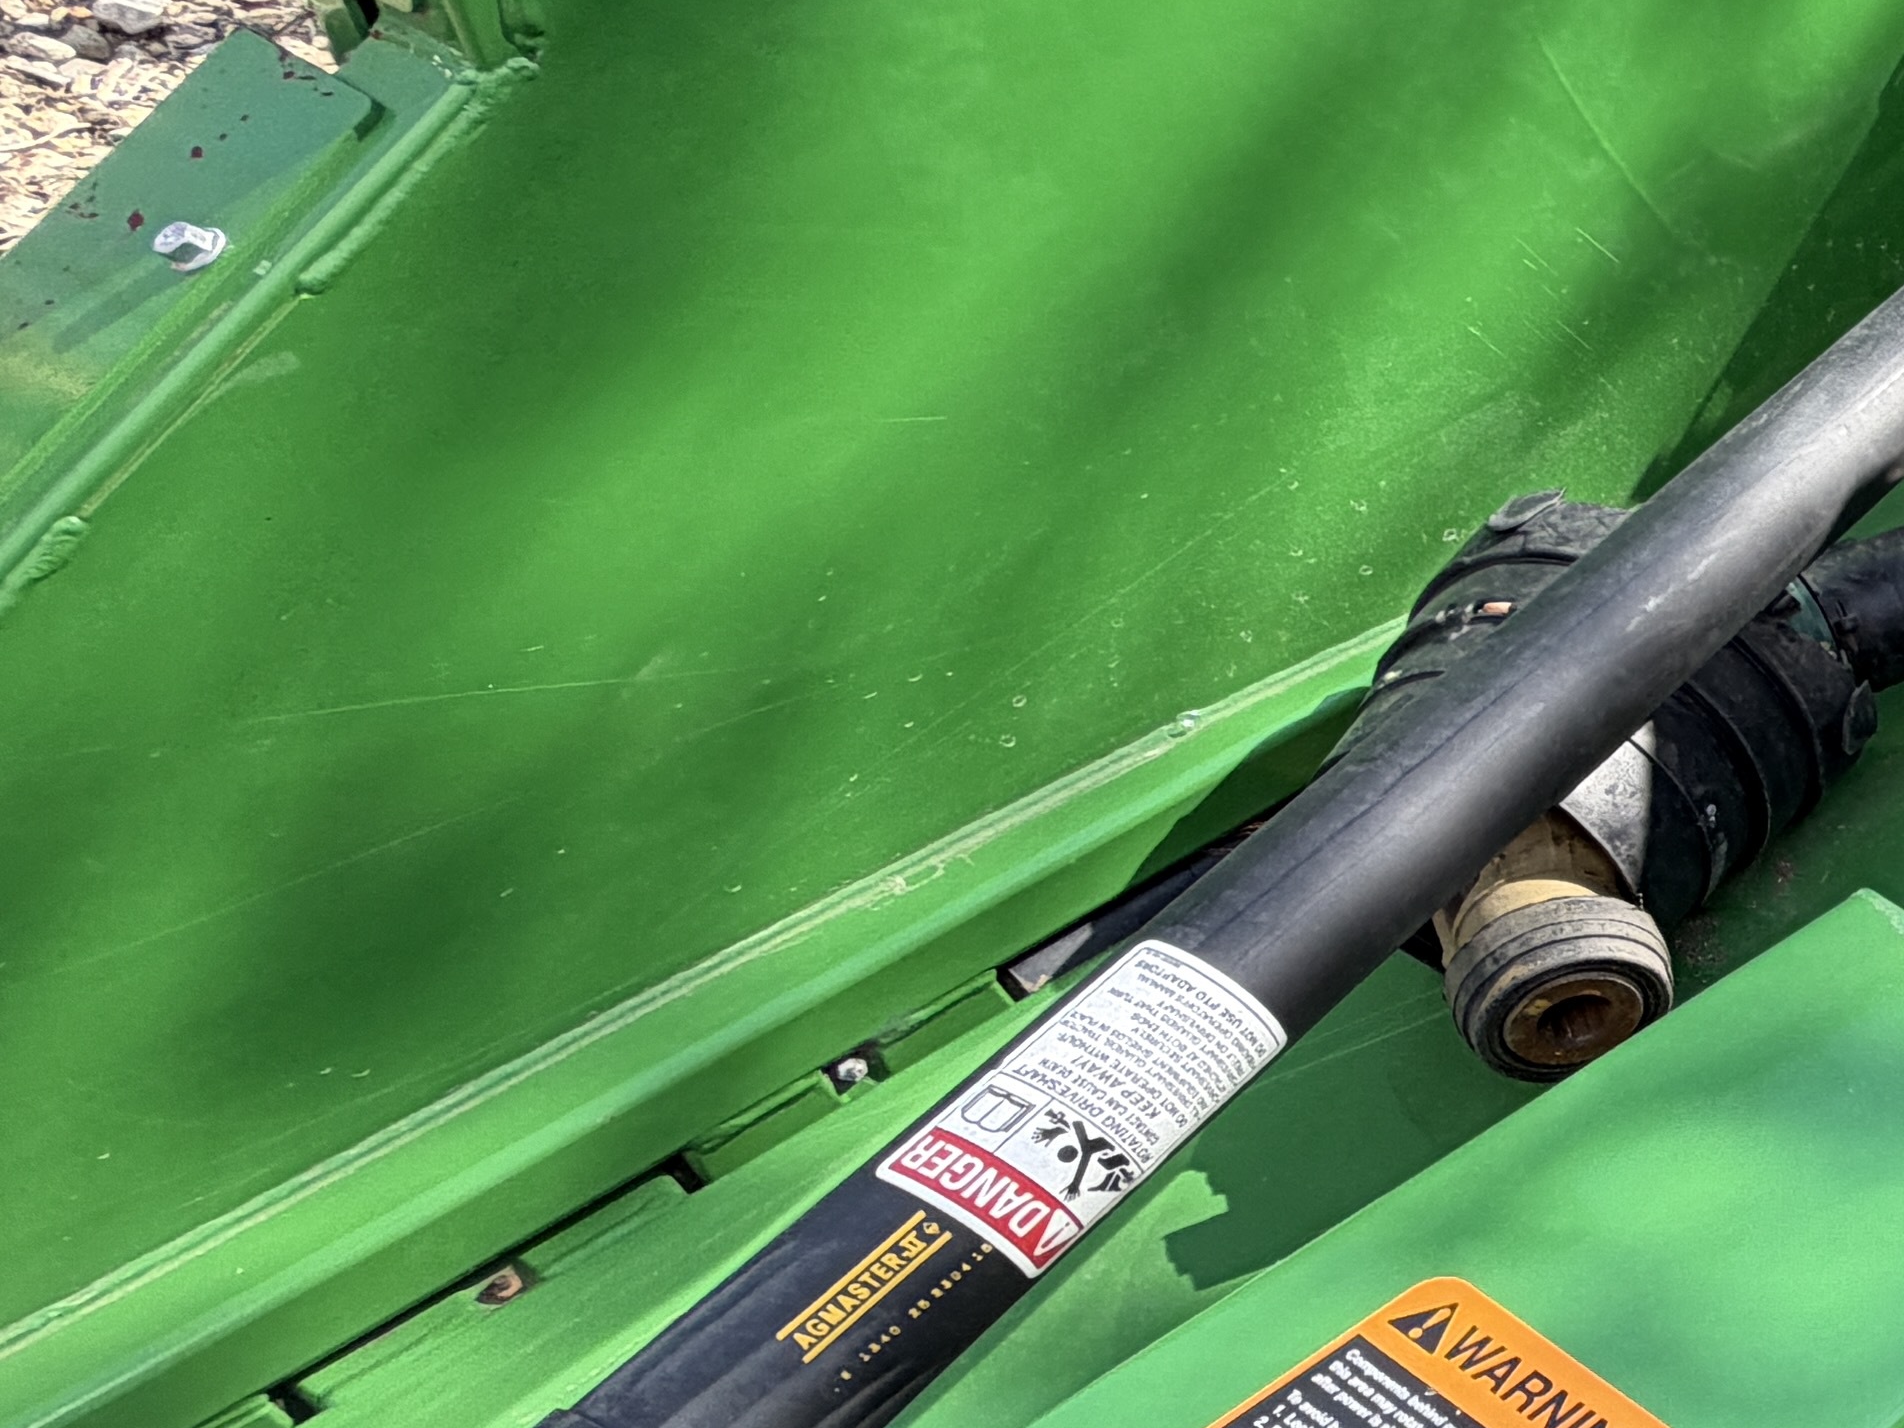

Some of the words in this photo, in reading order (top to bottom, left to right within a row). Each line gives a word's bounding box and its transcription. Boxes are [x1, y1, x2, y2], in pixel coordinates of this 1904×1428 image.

[900, 1128, 1047, 1237] DANGER
[1271, 1403, 1286, 1418] 1.
[1286, 1388, 1303, 1405] To
[1297, 1400, 1334, 1427] avoid
[1310, 1372, 1341, 1394] after
[1332, 1390, 1373, 1418] power
[1366, 1412, 1383, 1427] is
[1328, 1359, 1352, 1380] this
[1346, 1375, 1375, 1397] area
[1369, 1392, 1398, 1414] may
[1344, 1348, 1410, 1400] Components
[1406, 1394, 1448, 1426] behind
